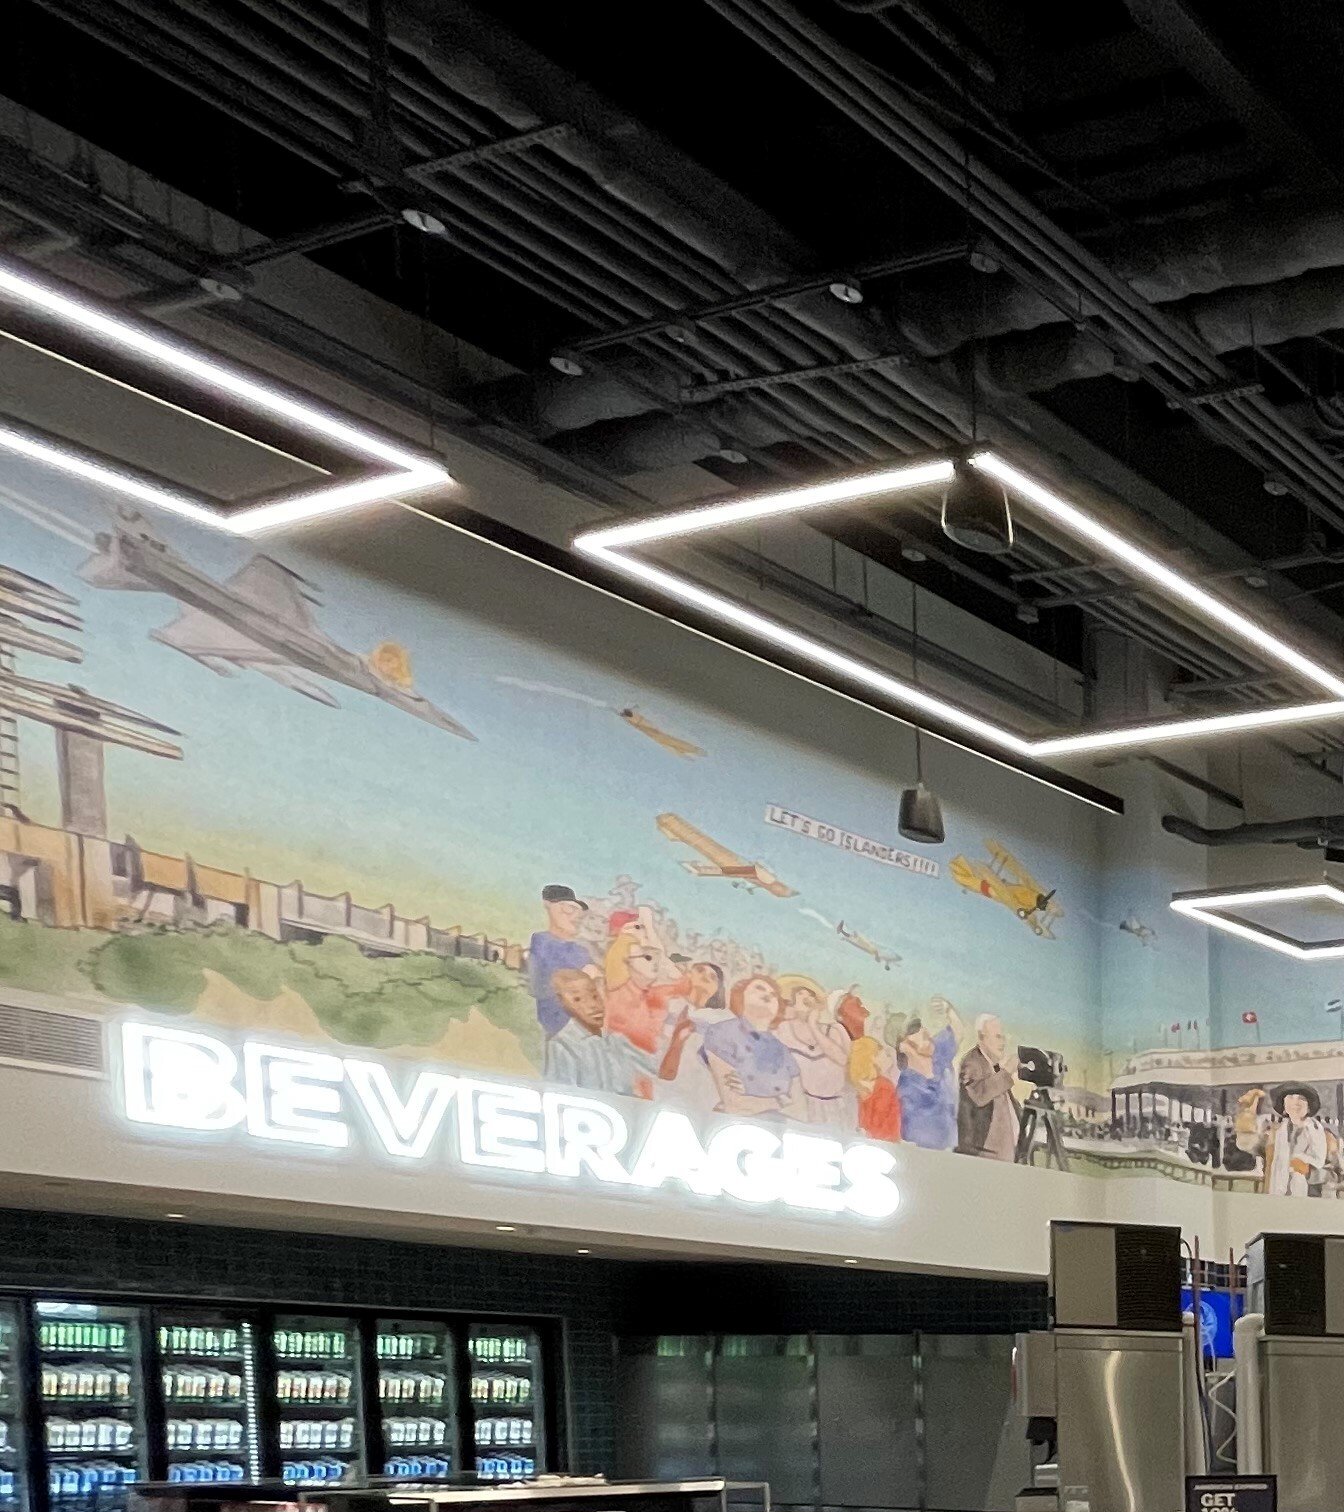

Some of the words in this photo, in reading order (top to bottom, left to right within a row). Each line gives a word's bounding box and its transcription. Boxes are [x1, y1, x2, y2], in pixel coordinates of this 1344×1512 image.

[769, 807, 812, 835] LET'S
[816, 824, 836, 842] GO
[119, 1020, 903, 1218] BEVERAGES
[1200, 1492, 1236, 1507] GET
